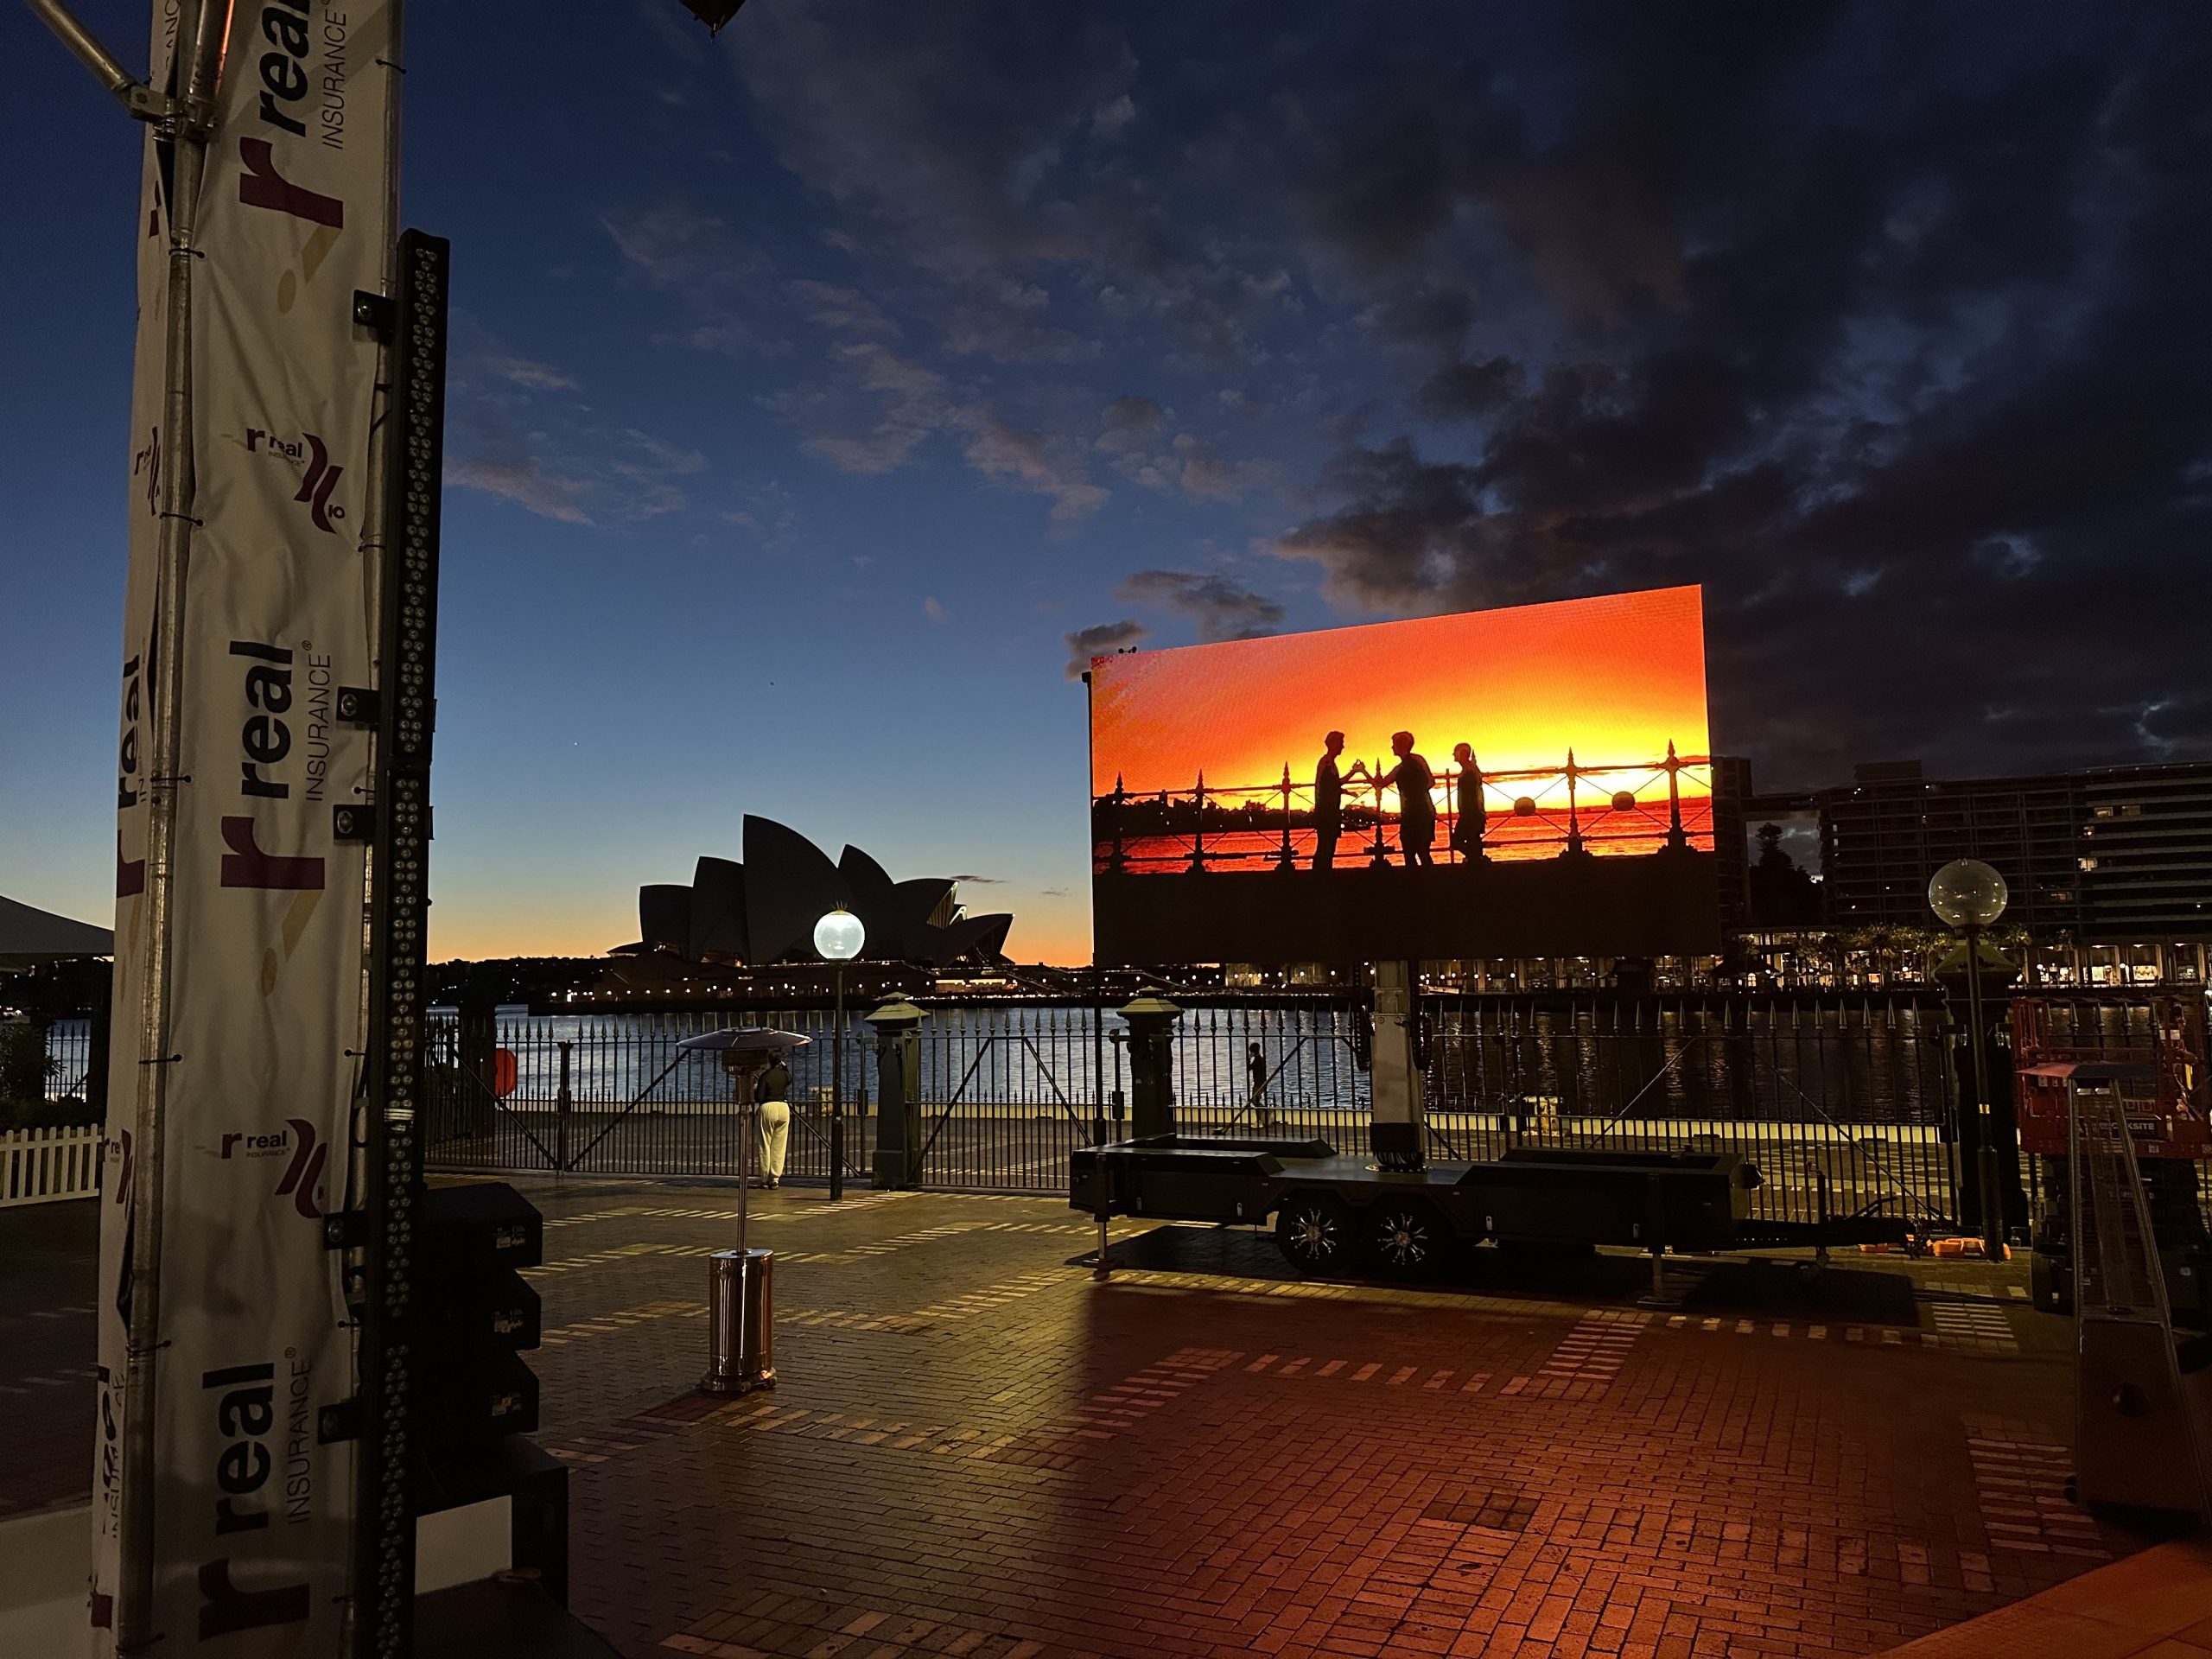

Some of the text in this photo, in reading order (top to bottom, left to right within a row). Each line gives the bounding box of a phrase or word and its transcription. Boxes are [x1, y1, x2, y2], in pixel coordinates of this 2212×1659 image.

[321, 9, 346, 149] INSURANCE
[240, 137, 343, 229] r
[221, 640, 325, 890] r real
[306, 654, 330, 801] INSURANCE
[222, 1130, 287, 1159] r real
[199, 1363, 310, 1643] r real
[287, 1359, 312, 1526] INSURANCE
